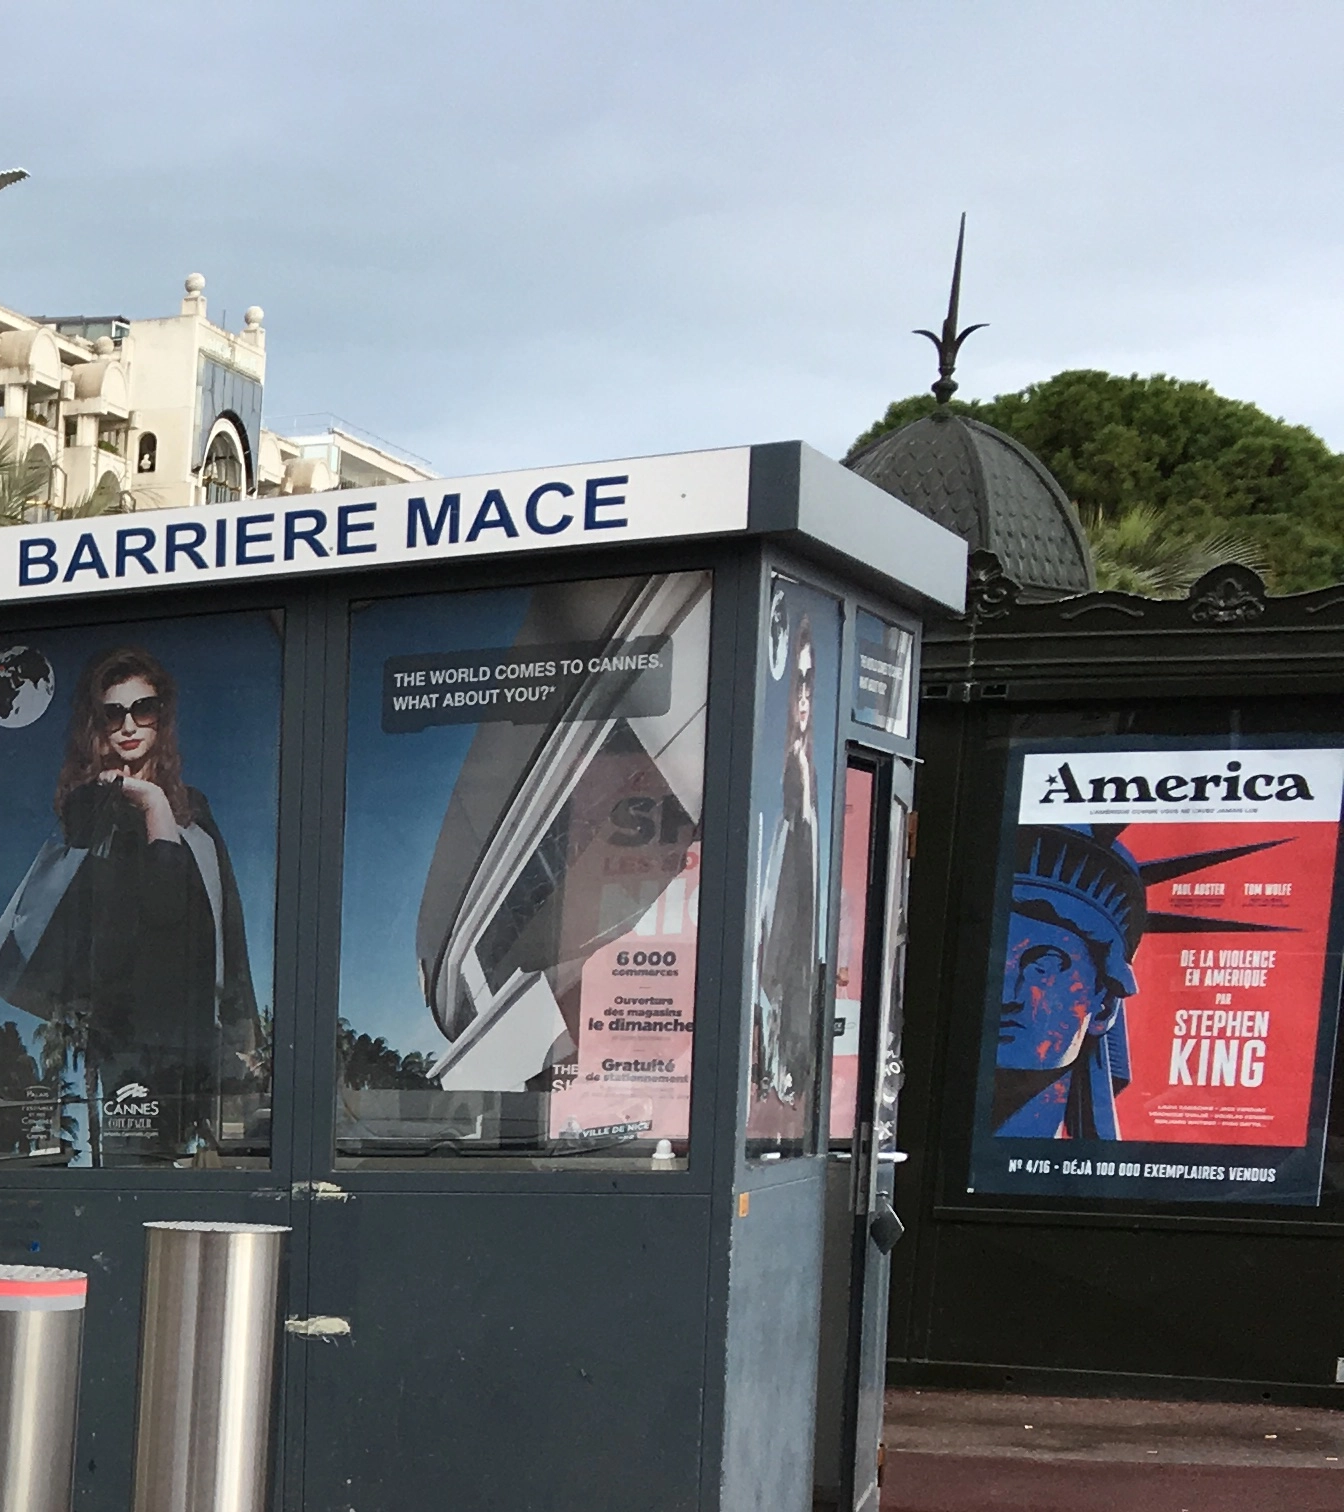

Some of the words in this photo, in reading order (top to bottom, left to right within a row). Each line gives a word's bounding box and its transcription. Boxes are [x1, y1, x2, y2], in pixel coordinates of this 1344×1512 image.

[18, 501, 377, 587] BARRIERE
[405, 475, 629, 549] MACE
[394, 670, 426, 688] THE
[430, 666, 490, 685] WORLD
[495, 661, 556, 680] COMES
[560, 659, 584, 676] TO
[588, 653, 664, 673] CANNES.
[393, 692, 440, 711] WHAT
[443, 689, 500, 708] ABOUT
[1039, 760, 1315, 804] America
[1172, 883, 1192, 895] PAUL
[1244, 883, 1262, 895] TOM
[1180, 949, 1196, 967] DE
[1199, 949, 1214, 967] LA
[1219, 949, 1277, 968] VIOLENCE
[611, 967, 679, 977] commerces
[1185, 968, 1201, 986] EN
[614, 996, 673, 1005] Ouverture
[1215, 993, 1232, 1005] PAR
[603, 1007, 624, 1017] des
[627, 1007, 683, 1018] magasins
[588, 1018, 605, 1031] le
[608, 1018, 695, 1032] dimanche
[1174, 1009, 1270, 1038] STEPHEN
[601, 1058, 676, 1073] Gratuité
[1169, 1038, 1267, 1088] KING
[585, 1072, 600, 1082] de
[603, 1074, 689, 1084] stationnement
[103, 1101, 160, 1116] CANNES
[582, 1127, 610, 1138] VILLE
[612, 1125, 625, 1134] DE
[627, 1122, 650, 1131] NICE
[1025, 1160, 1051, 1174] 4/16
[1062, 1159, 1092, 1175] DÉJÀ
[1096, 1162, 1115, 1176] 100
[1144, 1164, 1226, 1180] EXEMPLAIRES
[1228, 1166, 1277, 1182] VENDUS
